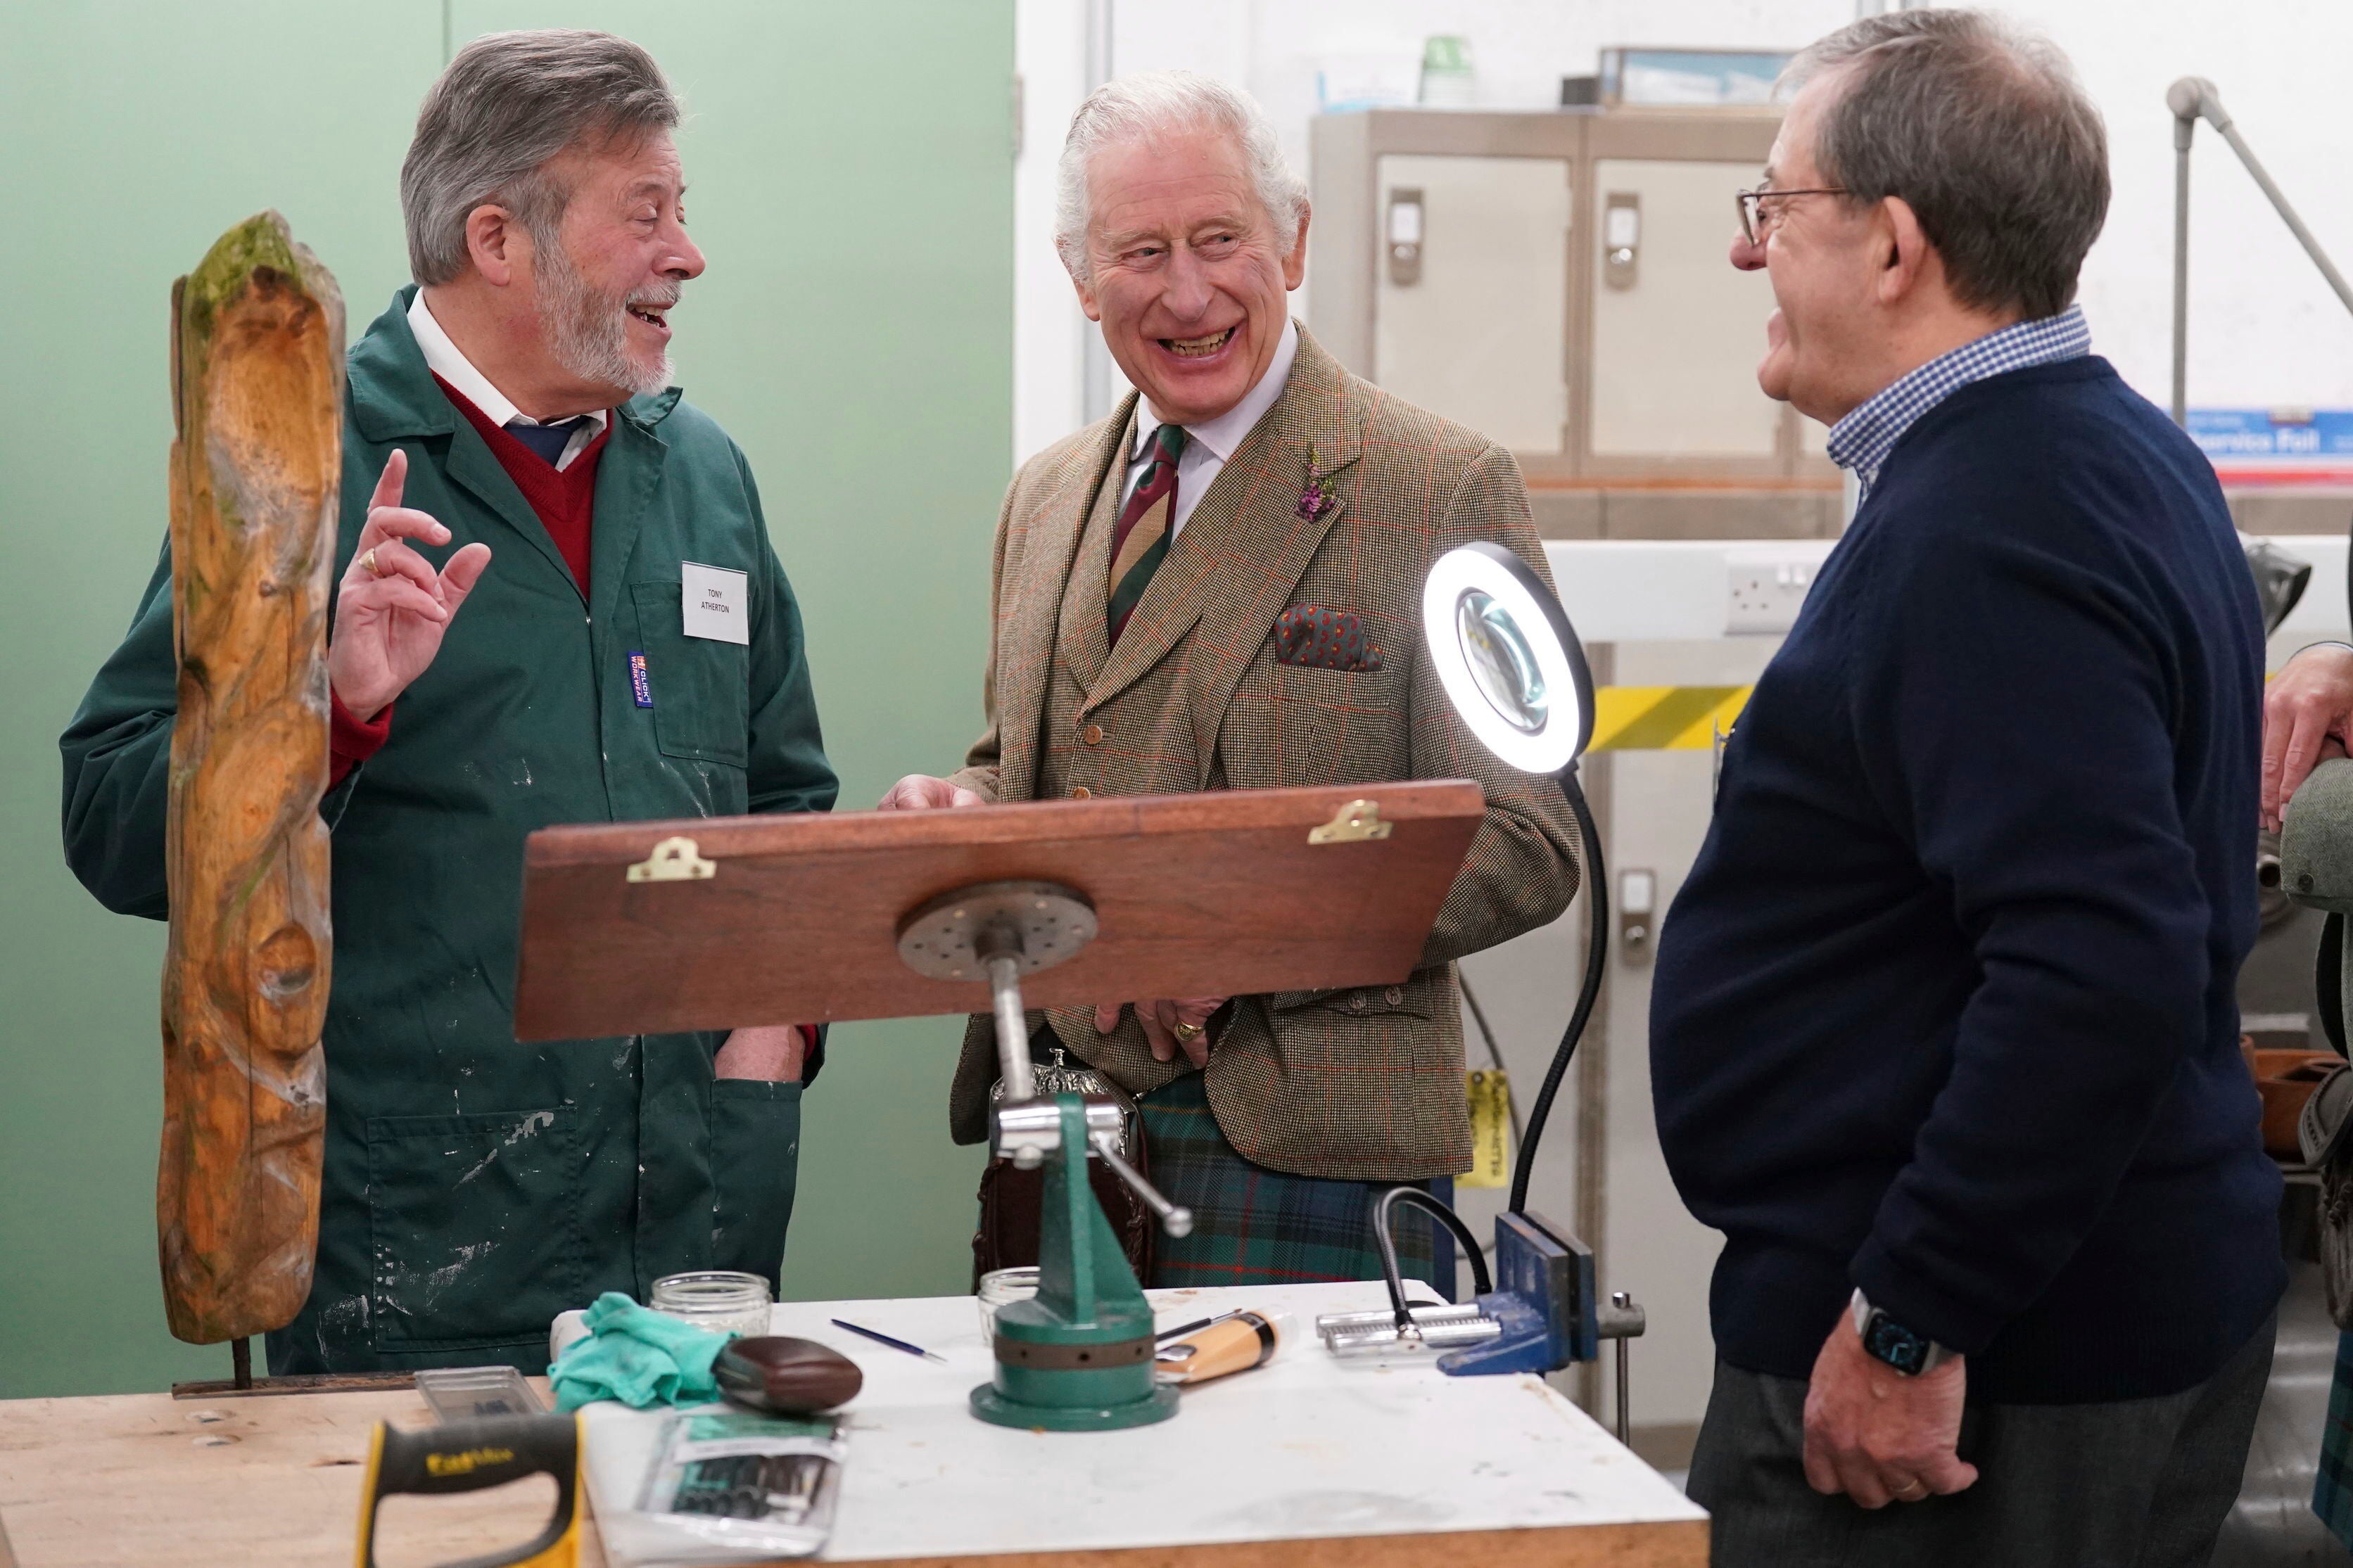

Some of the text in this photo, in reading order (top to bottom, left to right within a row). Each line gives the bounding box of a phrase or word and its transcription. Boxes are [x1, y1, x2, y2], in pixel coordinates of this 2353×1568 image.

[708, 589, 723, 599] TONY
[701, 601, 730, 613] ATHERTON
[631, 656, 642, 702] WORKWEAR
[640, 670, 649, 698] CLICK
